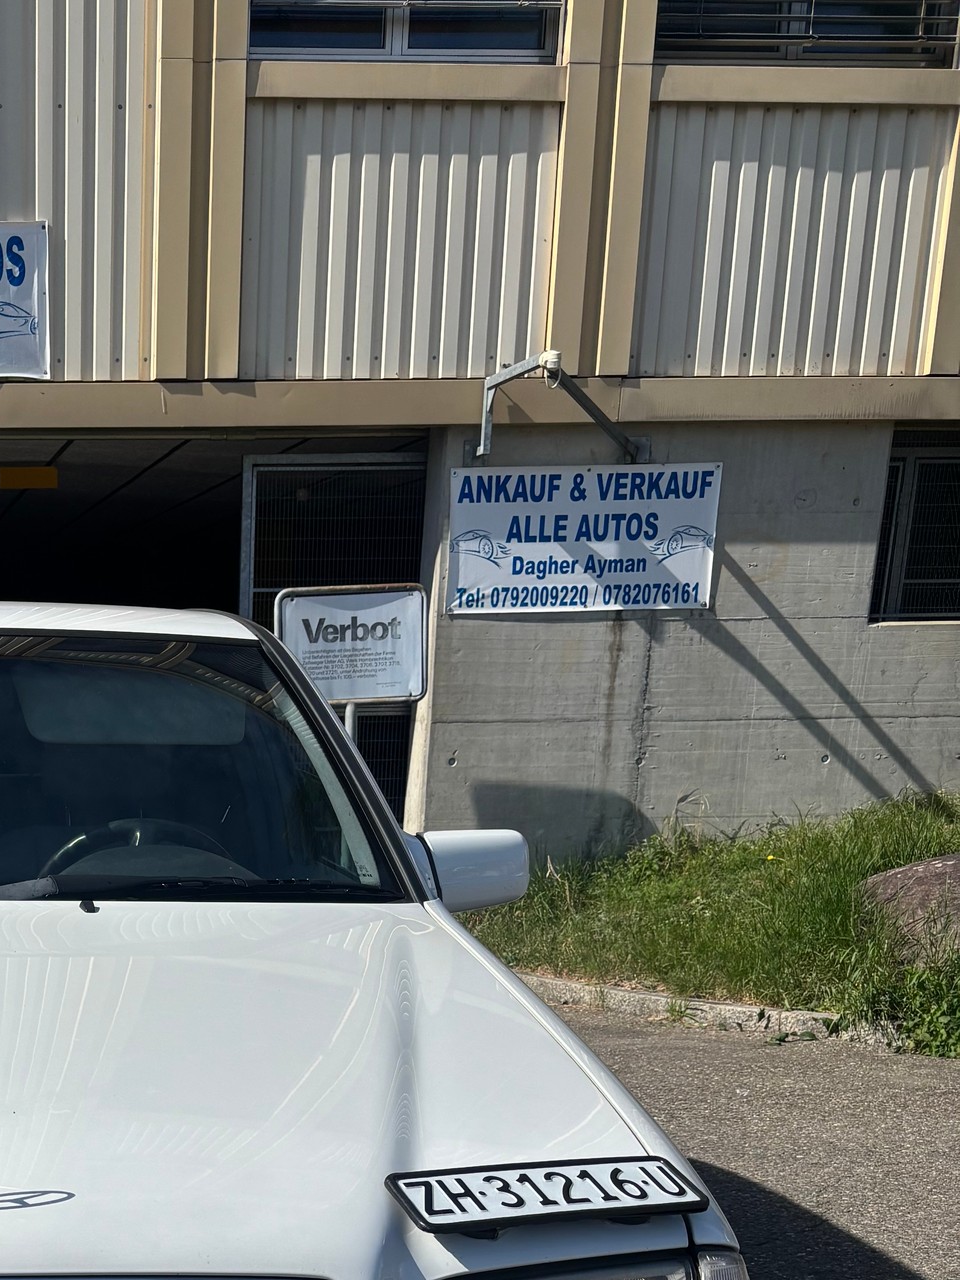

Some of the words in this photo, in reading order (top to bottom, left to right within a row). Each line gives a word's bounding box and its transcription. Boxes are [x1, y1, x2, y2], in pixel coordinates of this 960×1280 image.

[458, 475, 561, 503] ANKAUF
[570, 474, 587, 502] &
[597, 471, 715, 501] VERKAUF
[505, 515, 568, 543] ALLE
[574, 512, 659, 542] AUTOS
[511, 556, 579, 580] Dagher
[583, 555, 646, 579] Ayman
[455, 587, 485, 609] Tel:
[490, 585, 589, 609] 0792009220
[592, 584, 599, 606] /
[601, 582, 700, 606] 0782076161
[301, 616, 401, 643] Verbot
